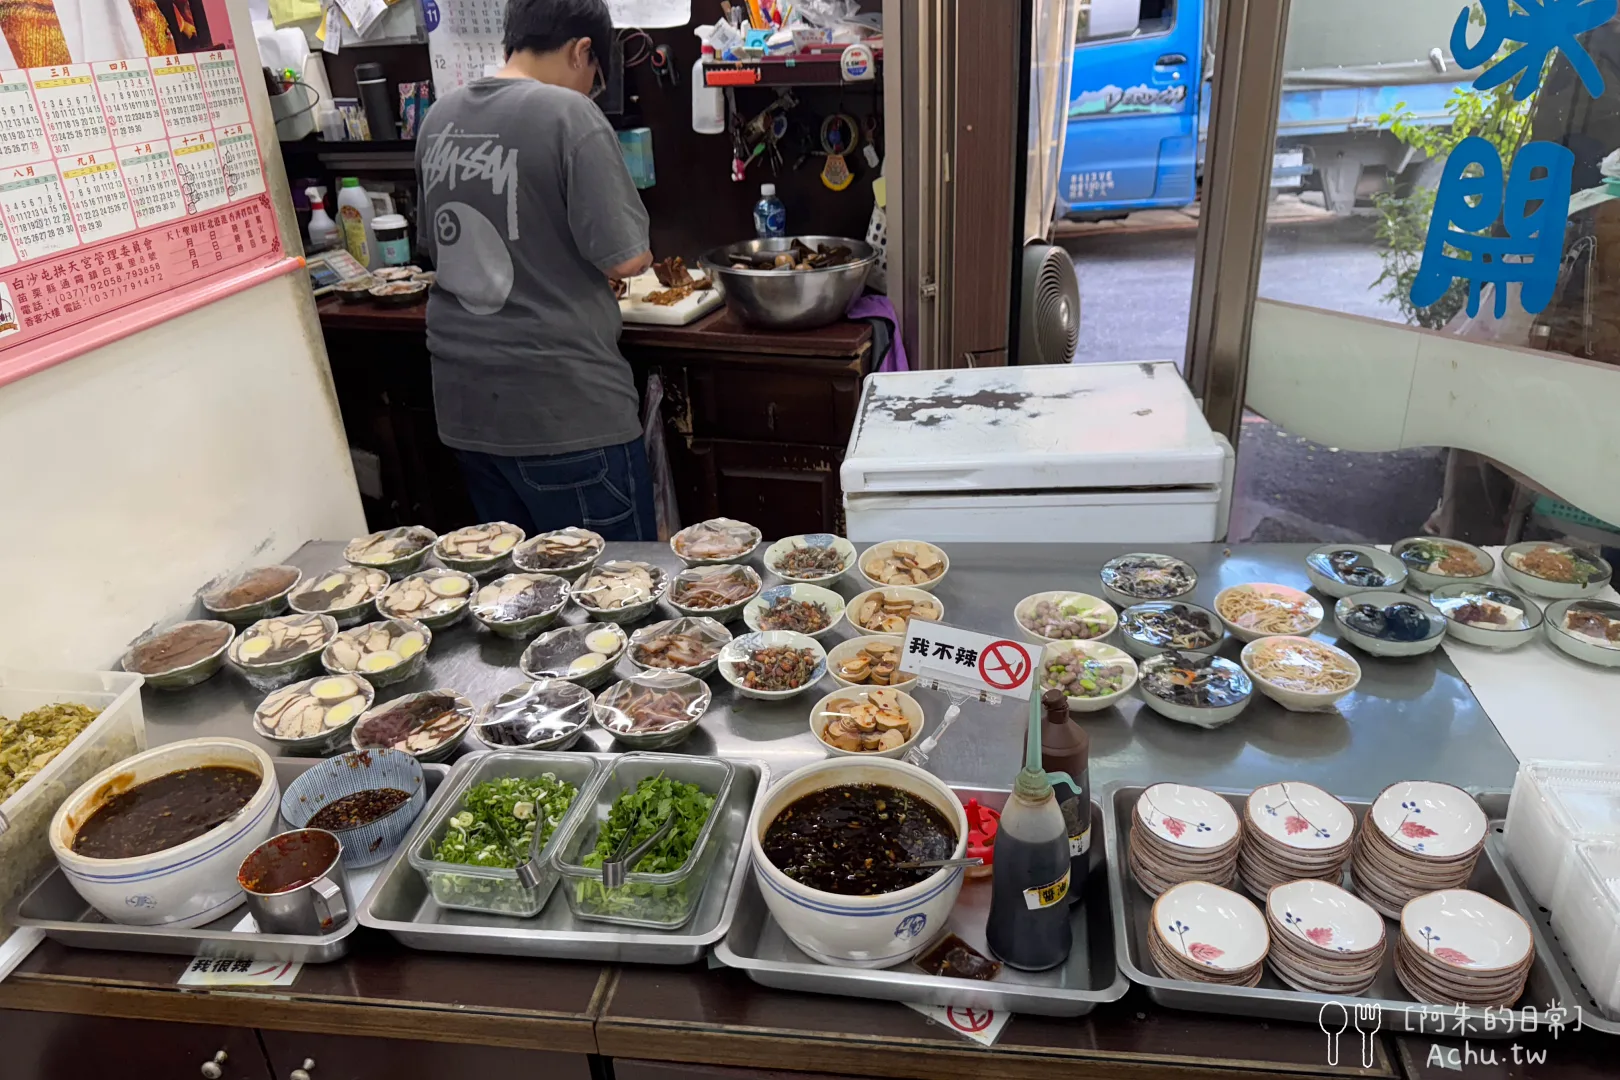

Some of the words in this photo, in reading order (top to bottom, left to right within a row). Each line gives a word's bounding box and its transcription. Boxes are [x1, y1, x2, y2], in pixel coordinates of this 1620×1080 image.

[427, 9, 438, 22] 11
[166, 56, 180, 65] 五月
[210, 52, 222, 60] 六月
[110, 61, 127, 70] 四月
[434, 58, 446, 69] 12
[51, 67, 70, 77] 三月
[88, 84, 93, 92] 1
[60, 109, 67, 117] 11
[80, 118, 88, 126] 20
[50, 134, 58, 142] 23
[75, 130, 82, 138] 26
[92, 127, 99, 135] 28
[100, 126, 108, 134] 29
[224, 126, 243, 135] 十二月
[182, 134, 206, 145] 十一月
[54, 145, 62, 153] 30
[135, 144, 152, 155] 十月
[77, 155, 96, 165] 九月
[14, 166, 34, 177] 八月
[74, 177, 80, 186] 1
[82, 175, 88, 184] 2
[112, 169, 117, 177] 6
[70, 191, 74, 199] 7
[97, 196, 103, 204] 17
[16, 213, 23, 221] 11
[24, 211, 32, 219] 12
[59, 202, 67, 210] 16
[76, 213, 83, 221] 21
[92, 209, 99, 217] 23
[11, 226, 19, 234] 17
[19, 224, 27, 232] 18
[34, 220, 43, 228] 20
[44, 218, 51, 226] 21
[62, 213, 70, 221] 23
[95, 220, 102, 228] 30
[438, 212, 456, 241] 8
[15, 238, 23, 246] 24
[23, 236, 31, 244] 25
[31, 234, 39, 242] 26
[39, 232, 46, 240] 27
[47, 229, 55, 237] 28
[56, 227, 64, 235] 29
[66, 224, 74, 232] 30
[186, 238, 194, 248] 月
[210, 231, 216, 240] 日
[20, 249, 28, 257] 31
[189, 249, 196, 259] 月
[212, 241, 219, 250] 日
[12, 238, 152, 290] 白沙屯拱天宮管理委員會
[192, 259, 199, 269] 月
[216, 252, 222, 261] 日
[24, 307, 61, 327] 香客大樓
[909, 637, 978, 667] 我不辣
[1042, 882, 1067, 902] 醬油
[191, 959, 254, 973] 我很辣
